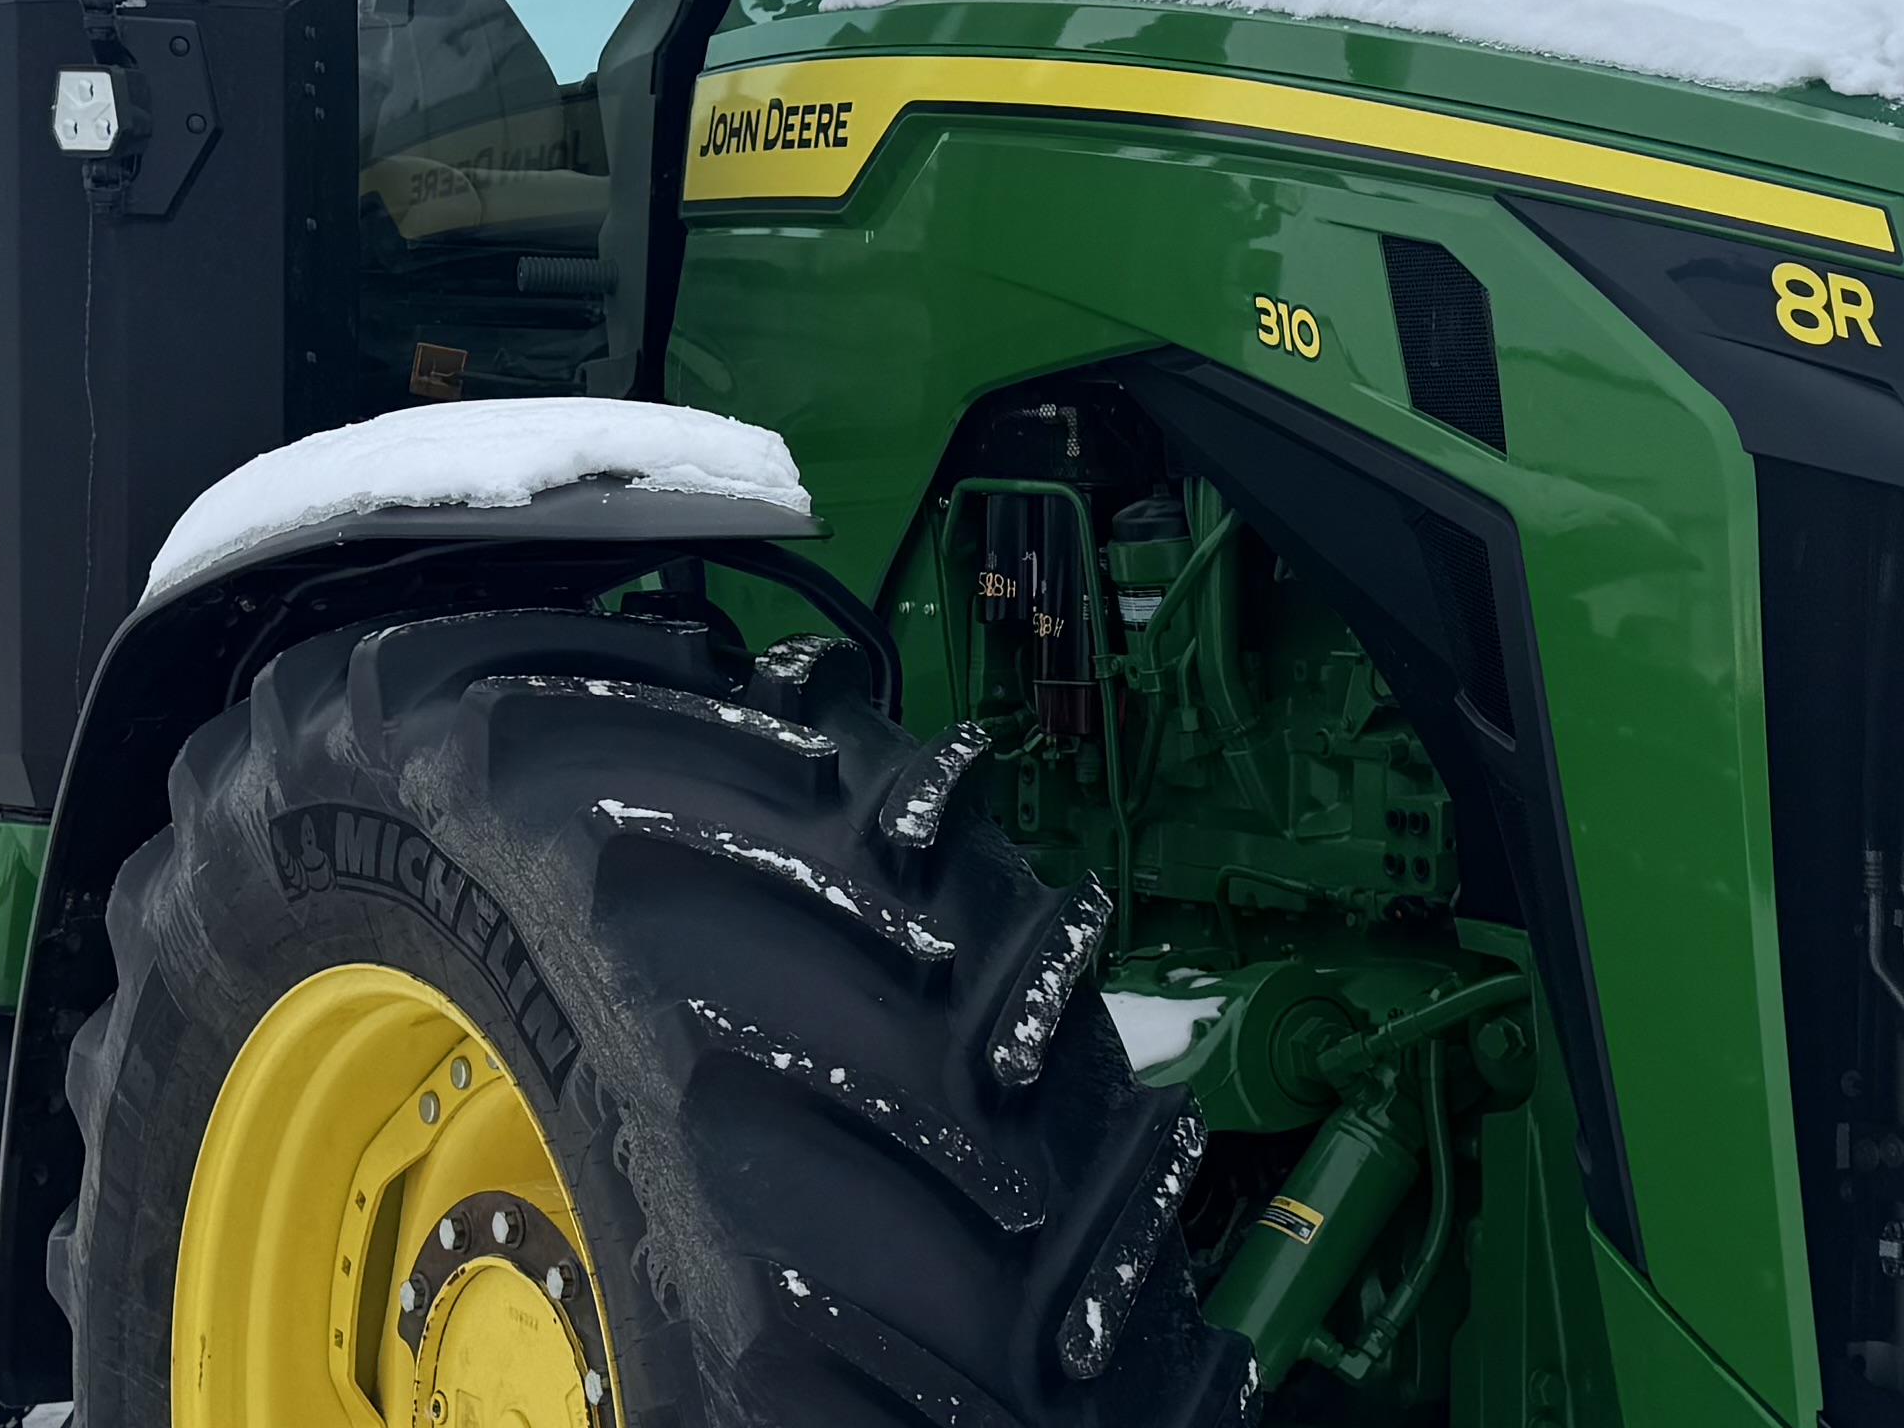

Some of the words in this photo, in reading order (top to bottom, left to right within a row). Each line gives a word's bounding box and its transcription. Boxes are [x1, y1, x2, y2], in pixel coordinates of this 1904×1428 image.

[700, 105, 761, 157] JOHN
[763, 98, 853, 151] DEERE
[1254, 294, 1321, 361] 310
[1771, 262, 1882, 347] 8R
[335, 810, 579, 1069] MICHELIN
